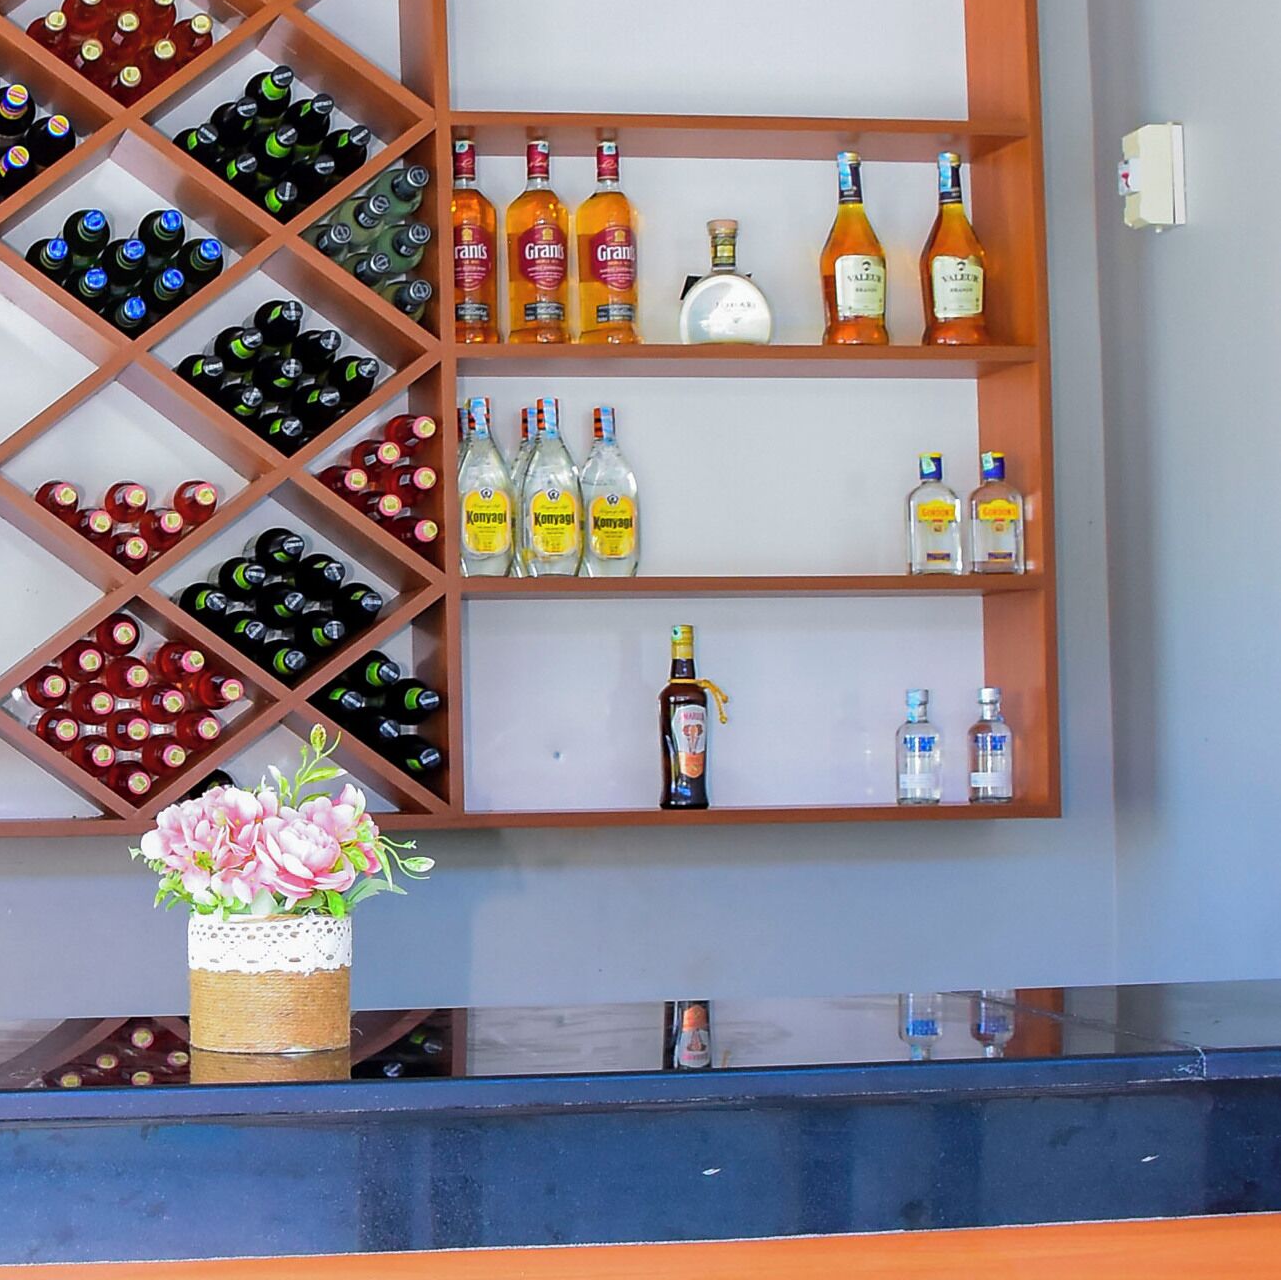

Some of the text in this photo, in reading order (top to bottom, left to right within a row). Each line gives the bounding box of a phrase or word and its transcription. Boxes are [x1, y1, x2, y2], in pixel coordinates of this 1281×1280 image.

[466, 510, 507, 526] Konyagi
[534, 511, 575, 527] Konyagi
[593, 515, 633, 531] Konyagi
